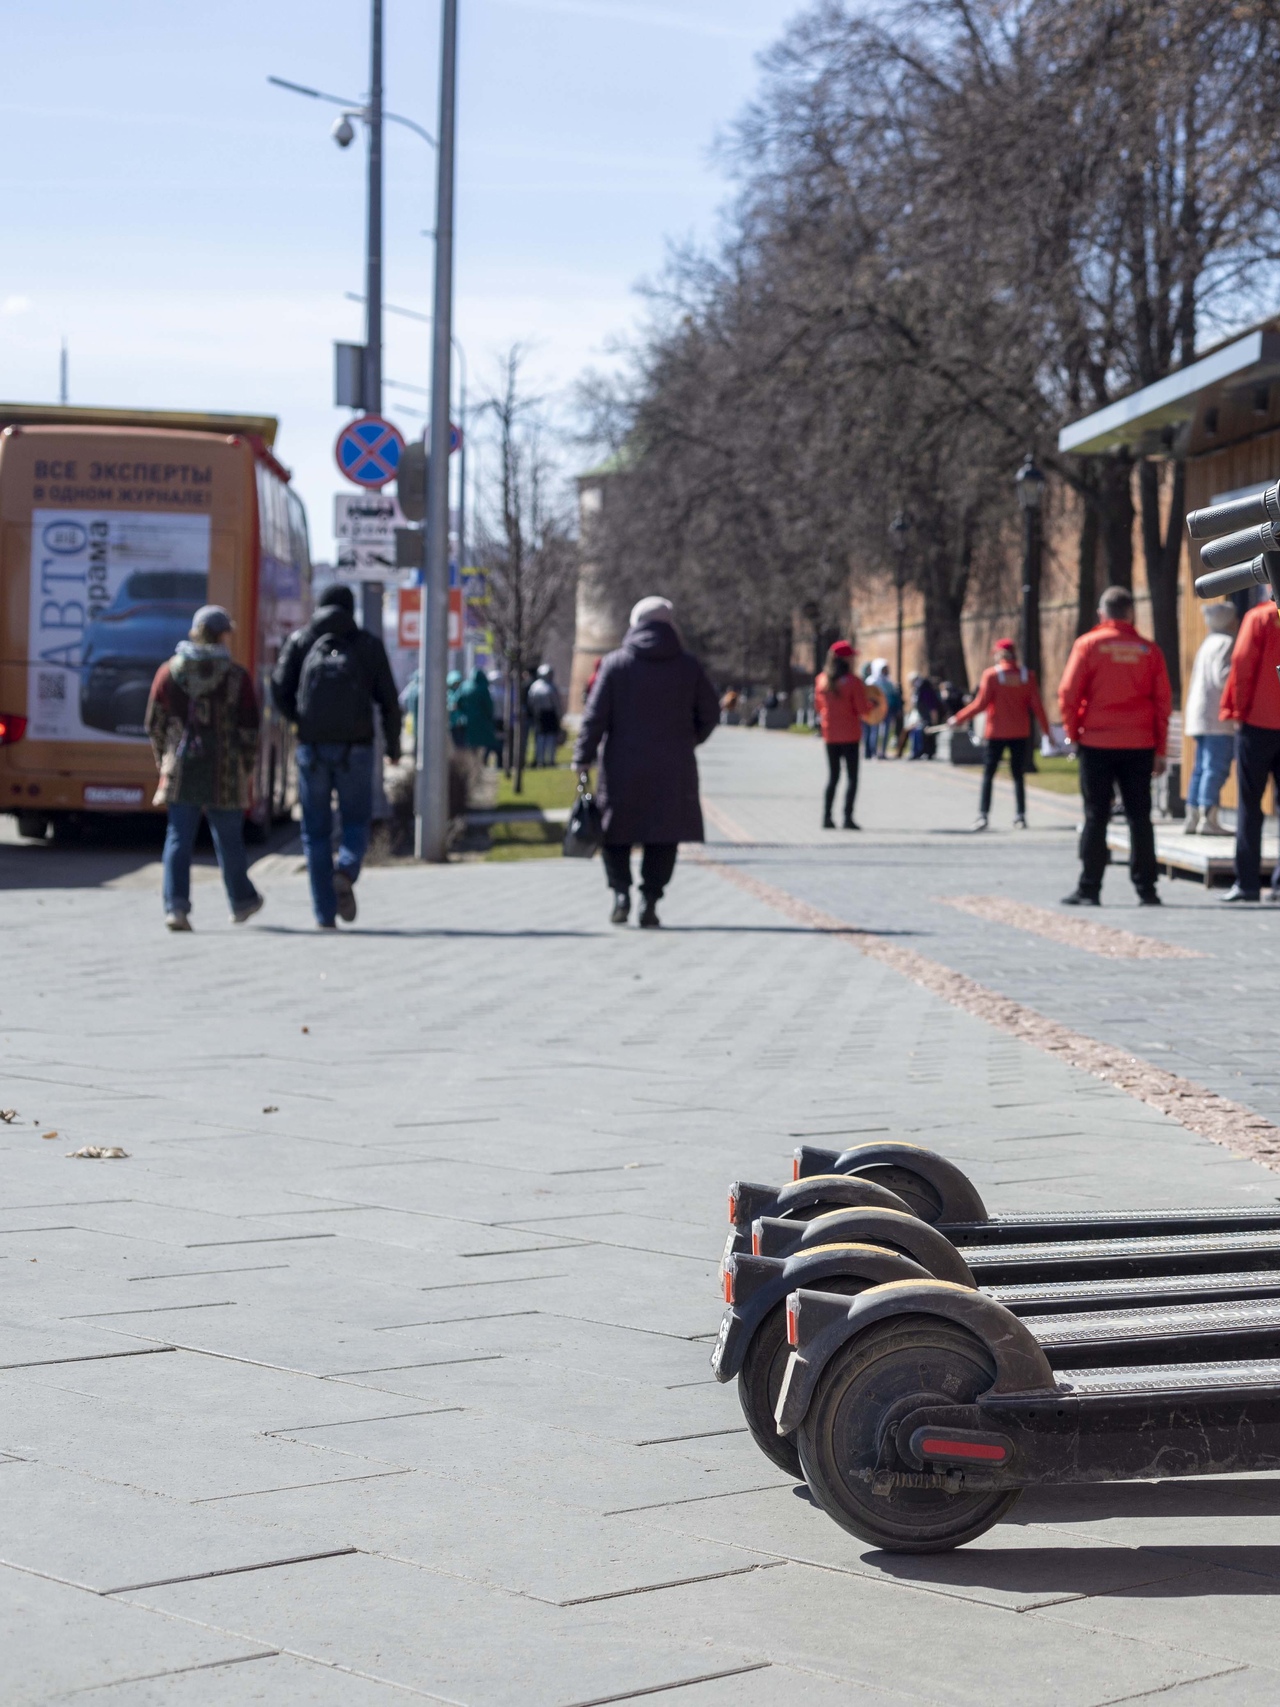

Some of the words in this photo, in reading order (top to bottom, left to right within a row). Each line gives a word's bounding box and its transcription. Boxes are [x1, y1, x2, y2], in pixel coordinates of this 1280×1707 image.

[34, 460, 77, 481] ВСЕ
[90, 461, 213, 485] ЭКСПЕРТЫ
[33, 485, 45, 501] В
[50, 486, 113, 503] ОДНОМ
[118, 487, 213, 506] ЖУРНАЛЕ!
[38, 518, 88, 674] АВТО
